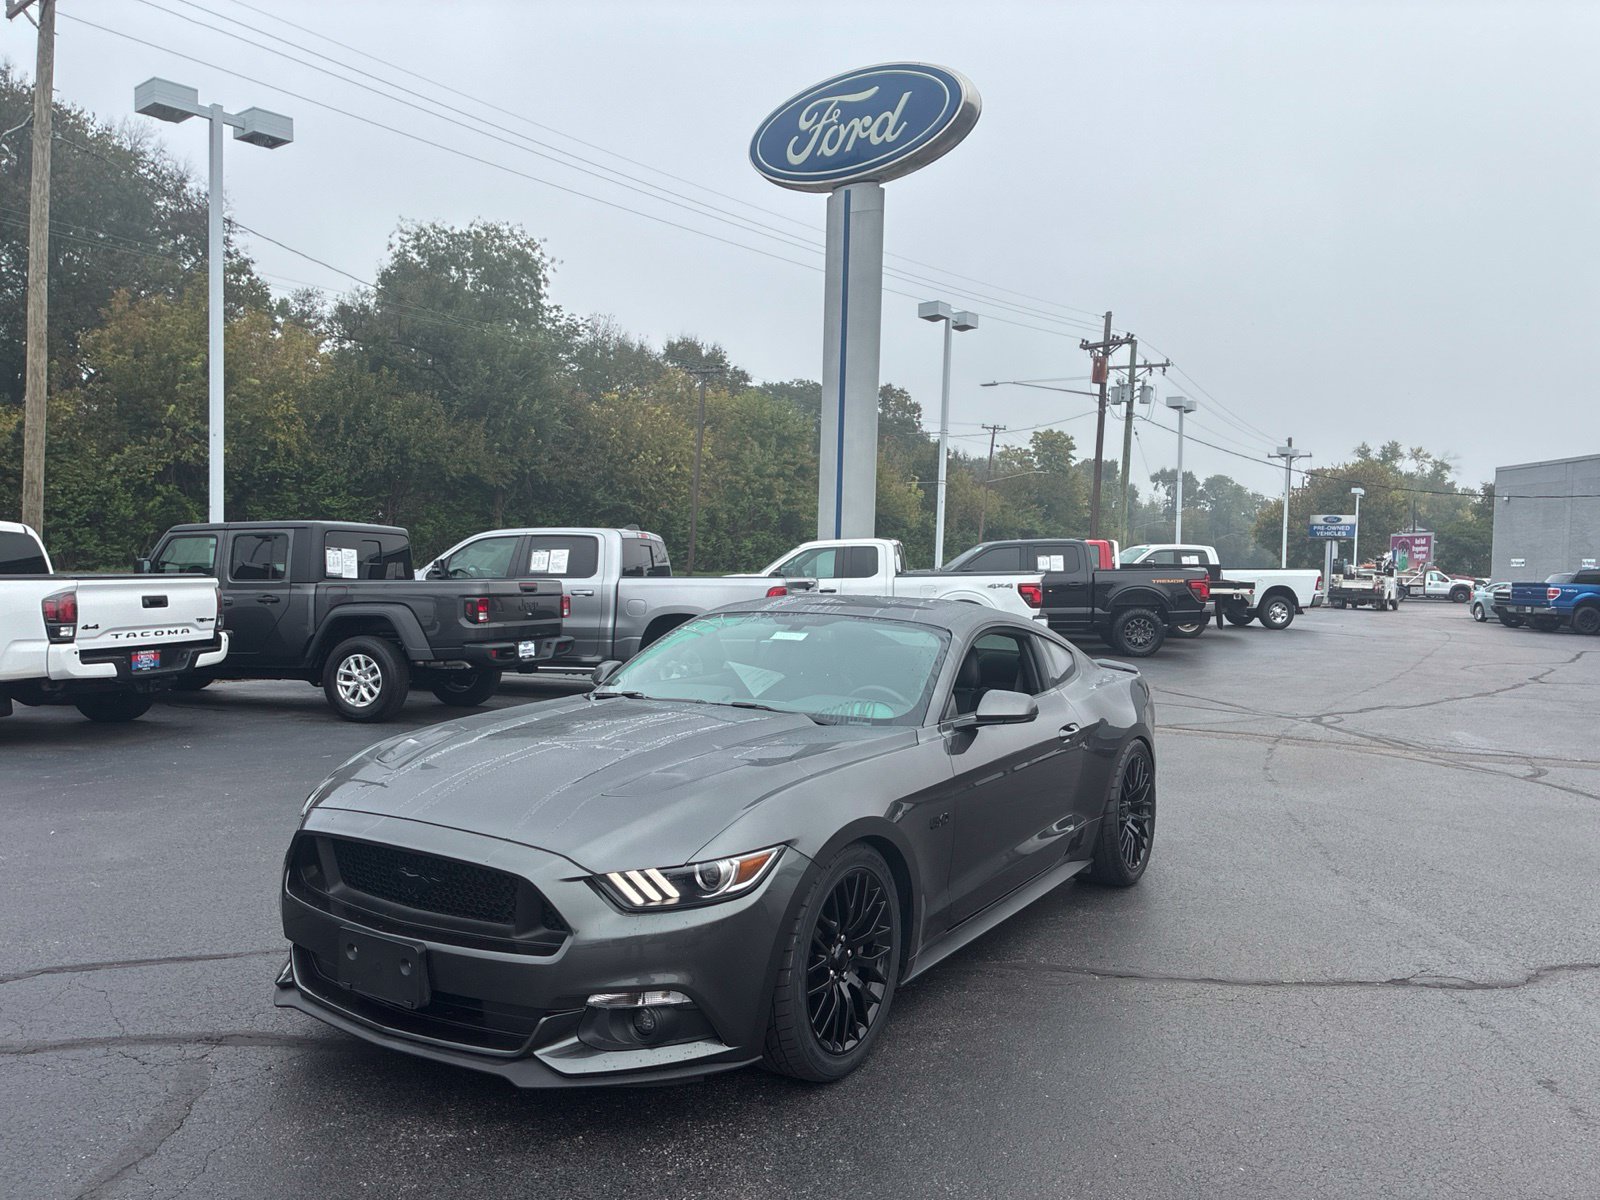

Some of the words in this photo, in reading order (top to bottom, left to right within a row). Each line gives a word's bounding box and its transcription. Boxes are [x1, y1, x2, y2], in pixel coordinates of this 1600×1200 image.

[787, 86, 912, 166] Ford
[518, 598, 539, 612] Jeep
[110, 628, 190, 639] TACOMA
